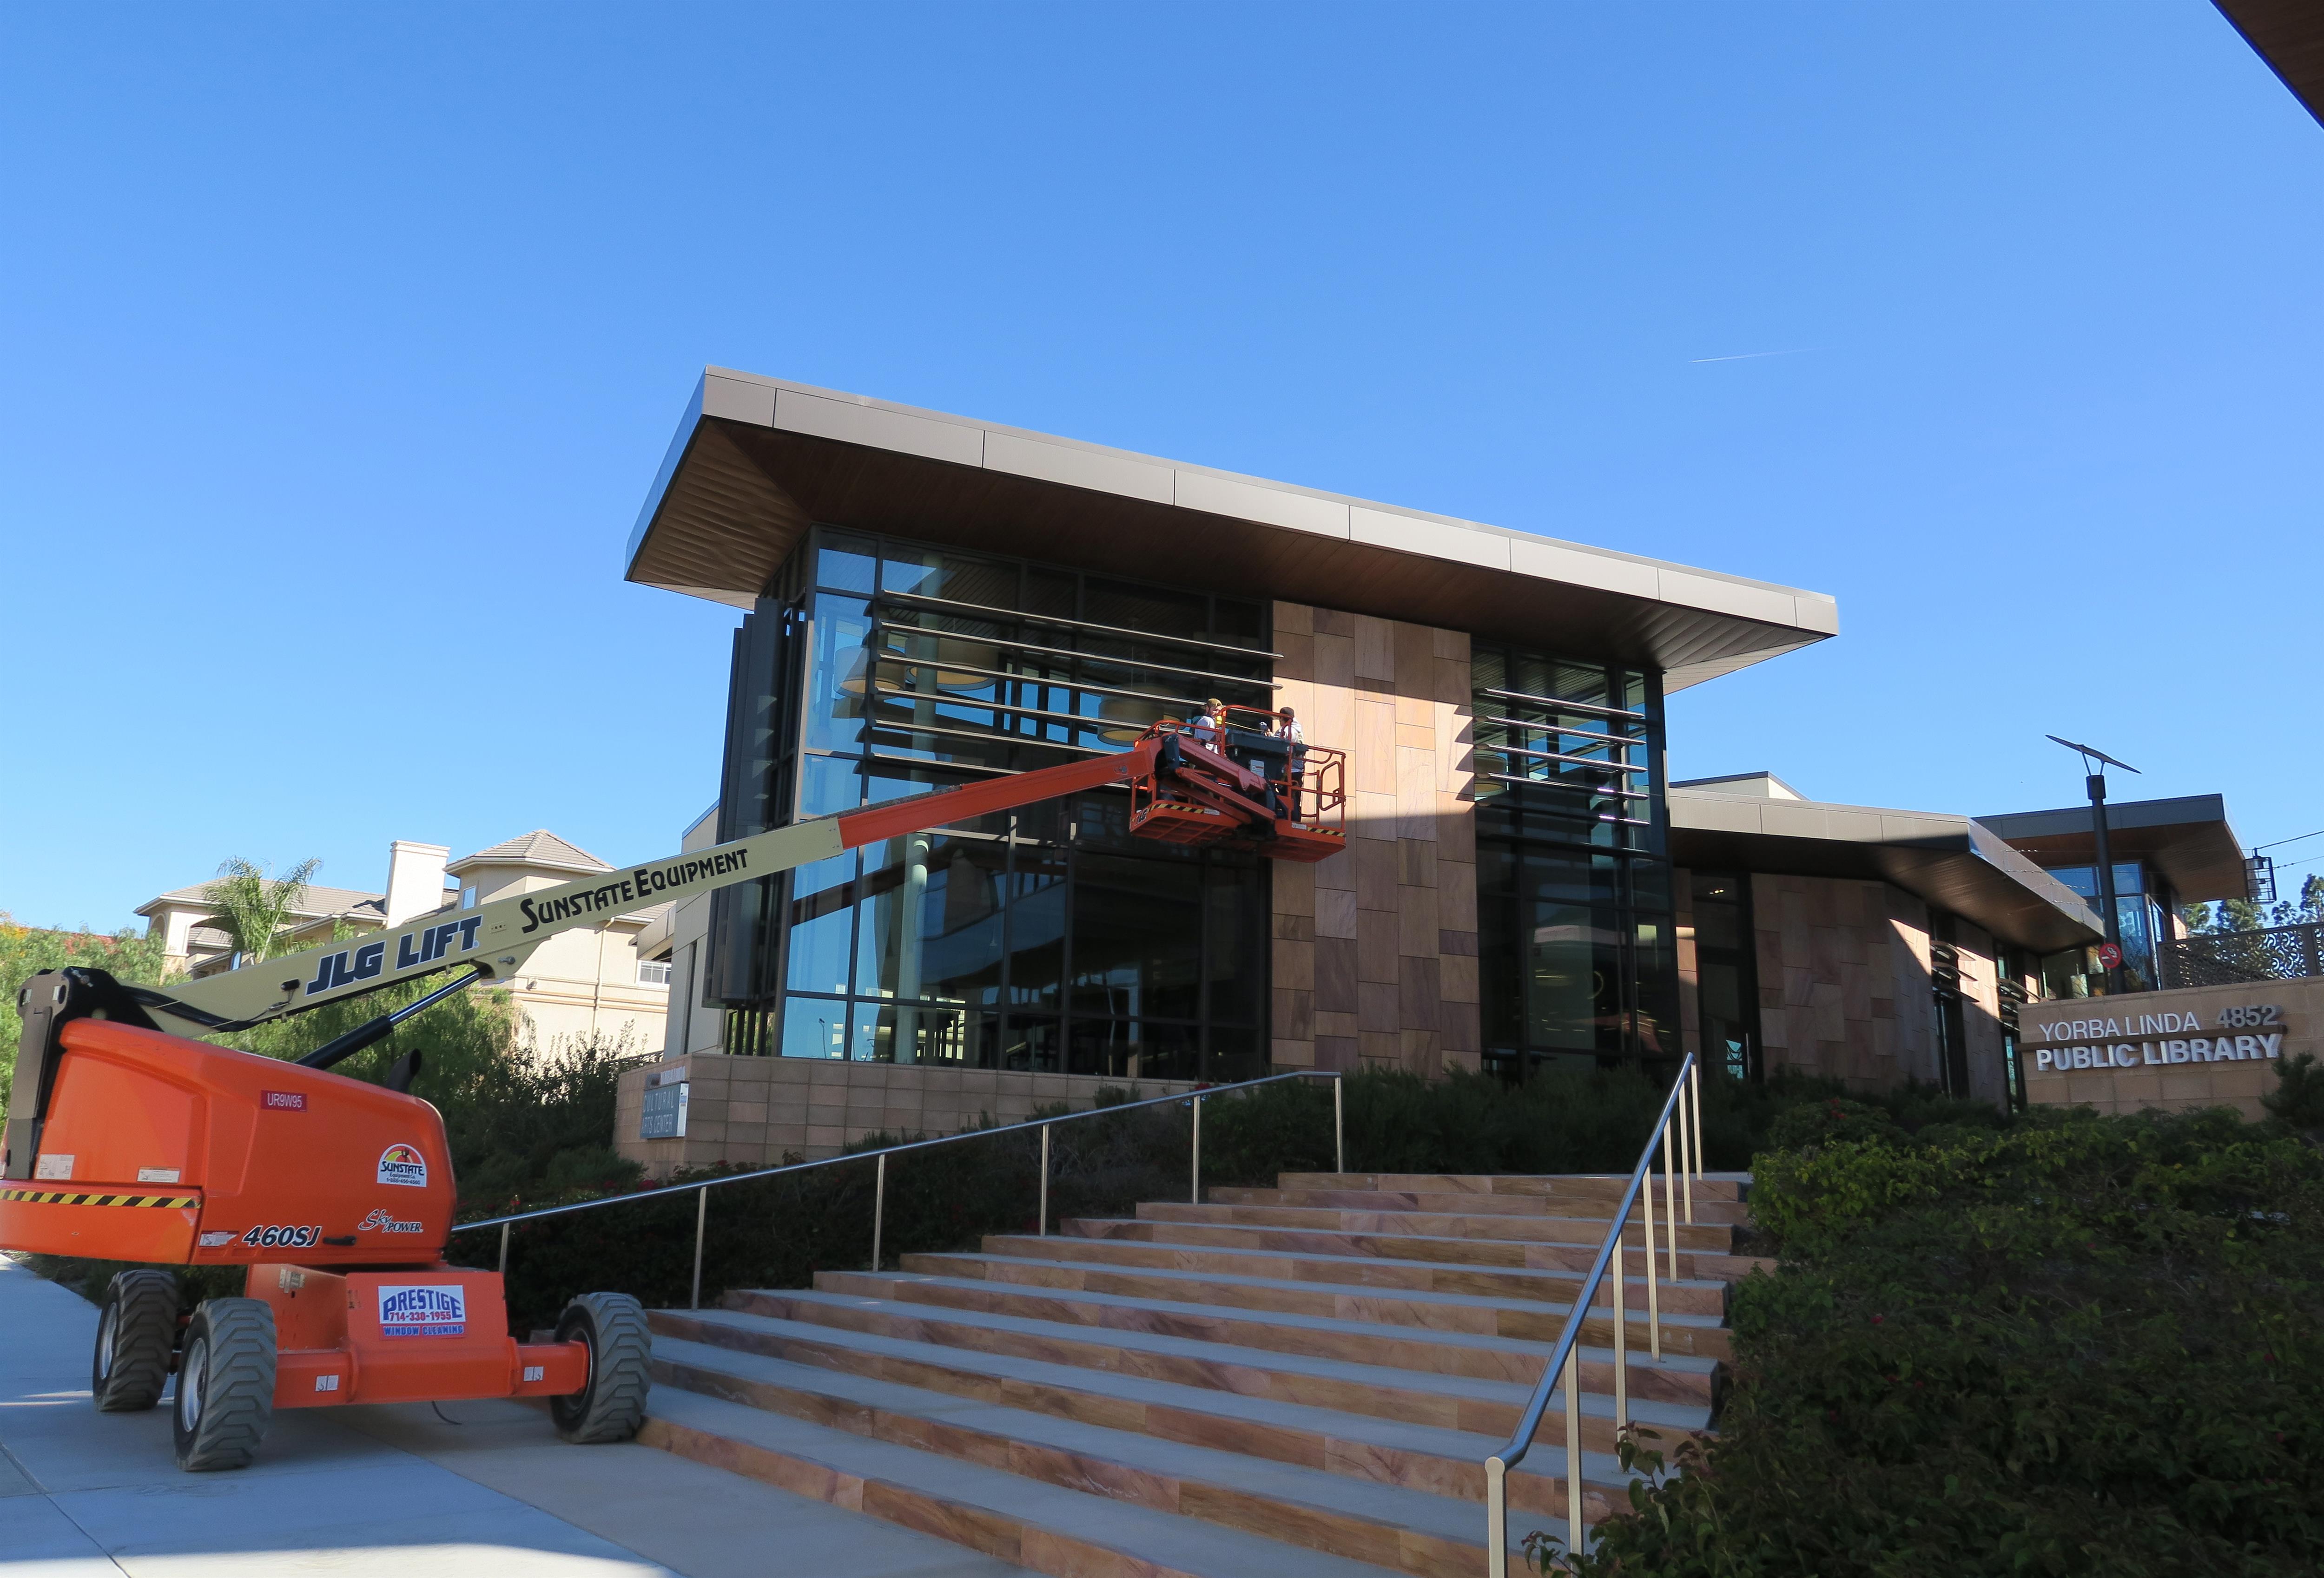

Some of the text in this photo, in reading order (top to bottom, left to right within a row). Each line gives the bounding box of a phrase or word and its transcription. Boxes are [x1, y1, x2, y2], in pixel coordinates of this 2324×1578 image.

[304, 914, 483, 996] JLG LIFT
[2039, 1004, 2280, 1042] YORBA LINDA 4852
[2036, 1033, 2283, 1071] PUBLIC LIBRARY
[267, 1093, 302, 1108] UR9W95
[380, 1161, 425, 1176] SUNSTATE
[241, 1225, 322, 1248] 460SJ
[383, 1289, 463, 1321] PRESTIGE
[389, 1311, 452, 1322] 714-330-1955
[383, 1325, 464, 1336] WINDOW CLEANING
